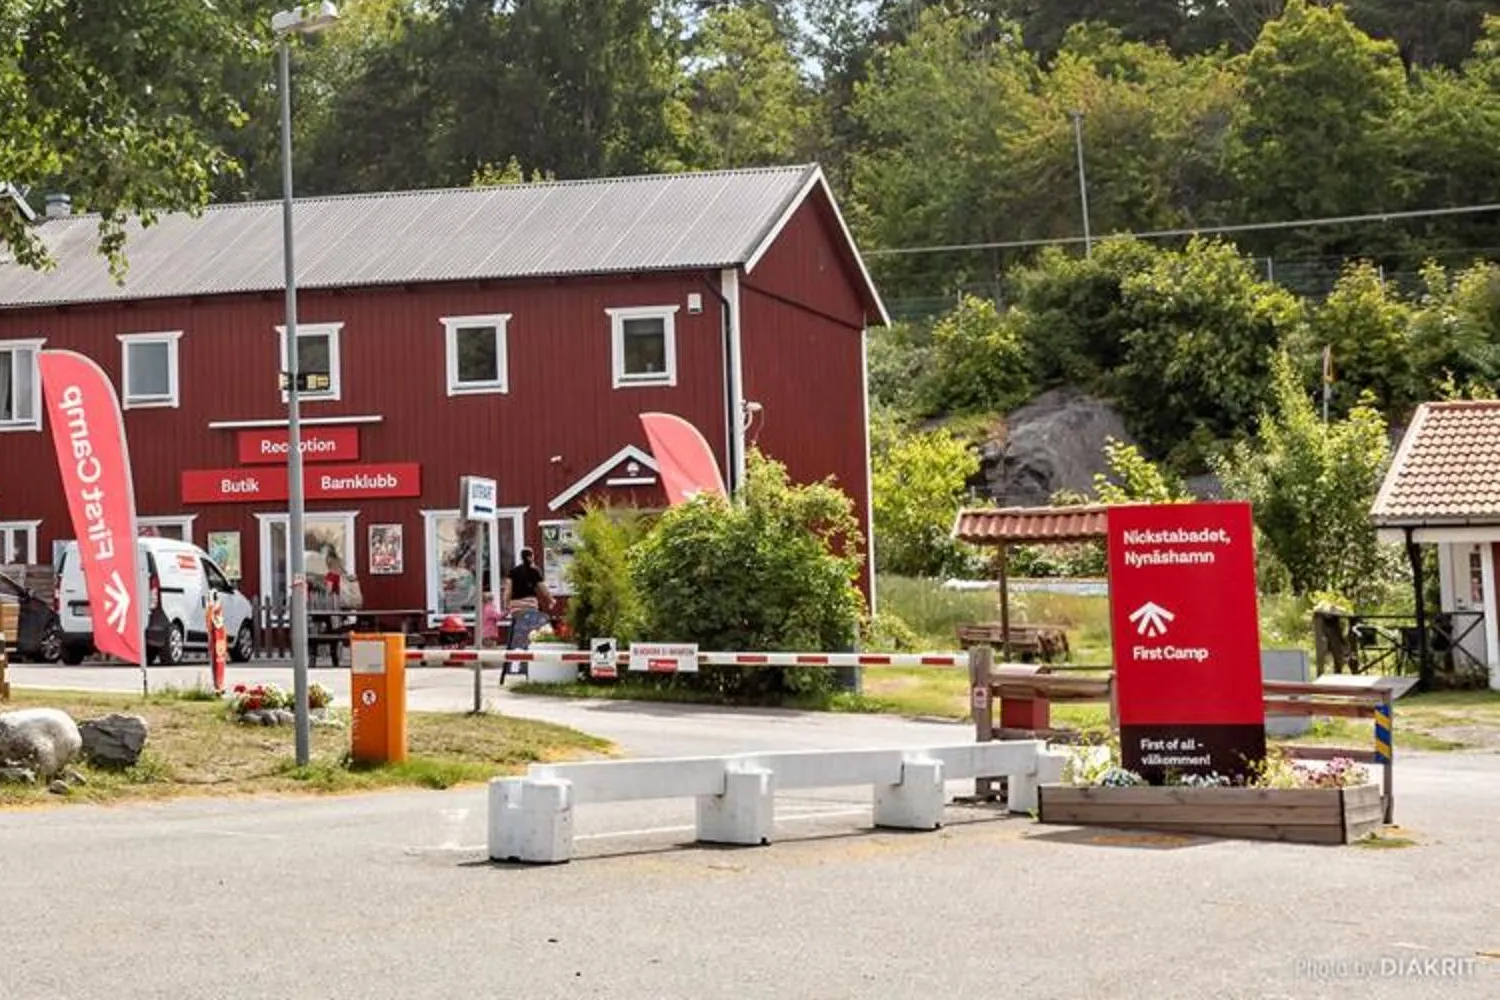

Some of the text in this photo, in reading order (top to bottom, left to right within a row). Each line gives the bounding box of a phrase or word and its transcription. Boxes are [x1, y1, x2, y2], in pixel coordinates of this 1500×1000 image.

[261, 436, 336, 454] Recption
[221, 473, 398, 493] Butik Barnklubb
[1123, 527, 1232, 546] Nickstabadet,
[1124, 549, 1215, 568] Nynäshamn
[1132, 645, 1209, 663] First Camp
[1140, 738, 1164, 750] First
[1165, 738, 1179, 750] of
[1180, 738, 1196, 750] all
